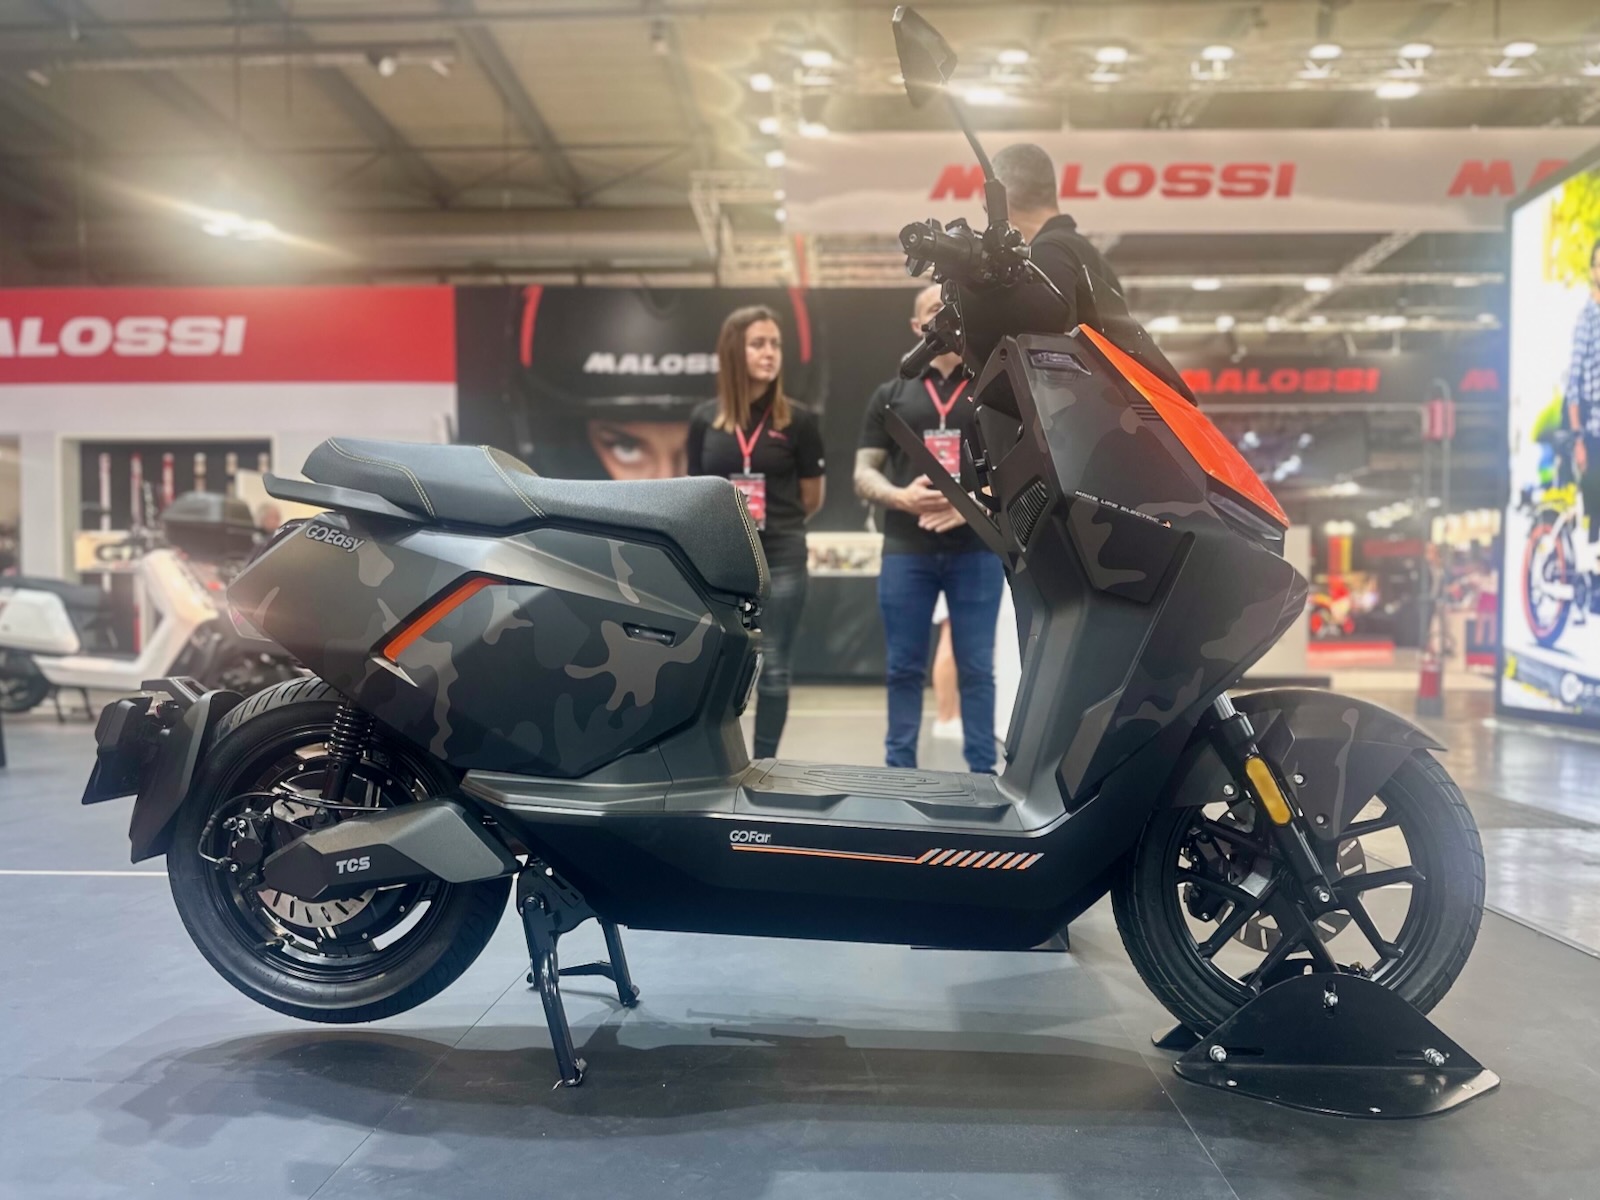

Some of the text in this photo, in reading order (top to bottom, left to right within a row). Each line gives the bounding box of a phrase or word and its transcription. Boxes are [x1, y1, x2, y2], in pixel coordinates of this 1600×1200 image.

[930, 162, 1296, 201] MLOSSI
[1178, 368, 1380, 393] MALOSSI
[305, 524, 365, 553] GOEasy
[729, 829, 771, 843] GOFar
[335, 855, 371, 874] TCS
